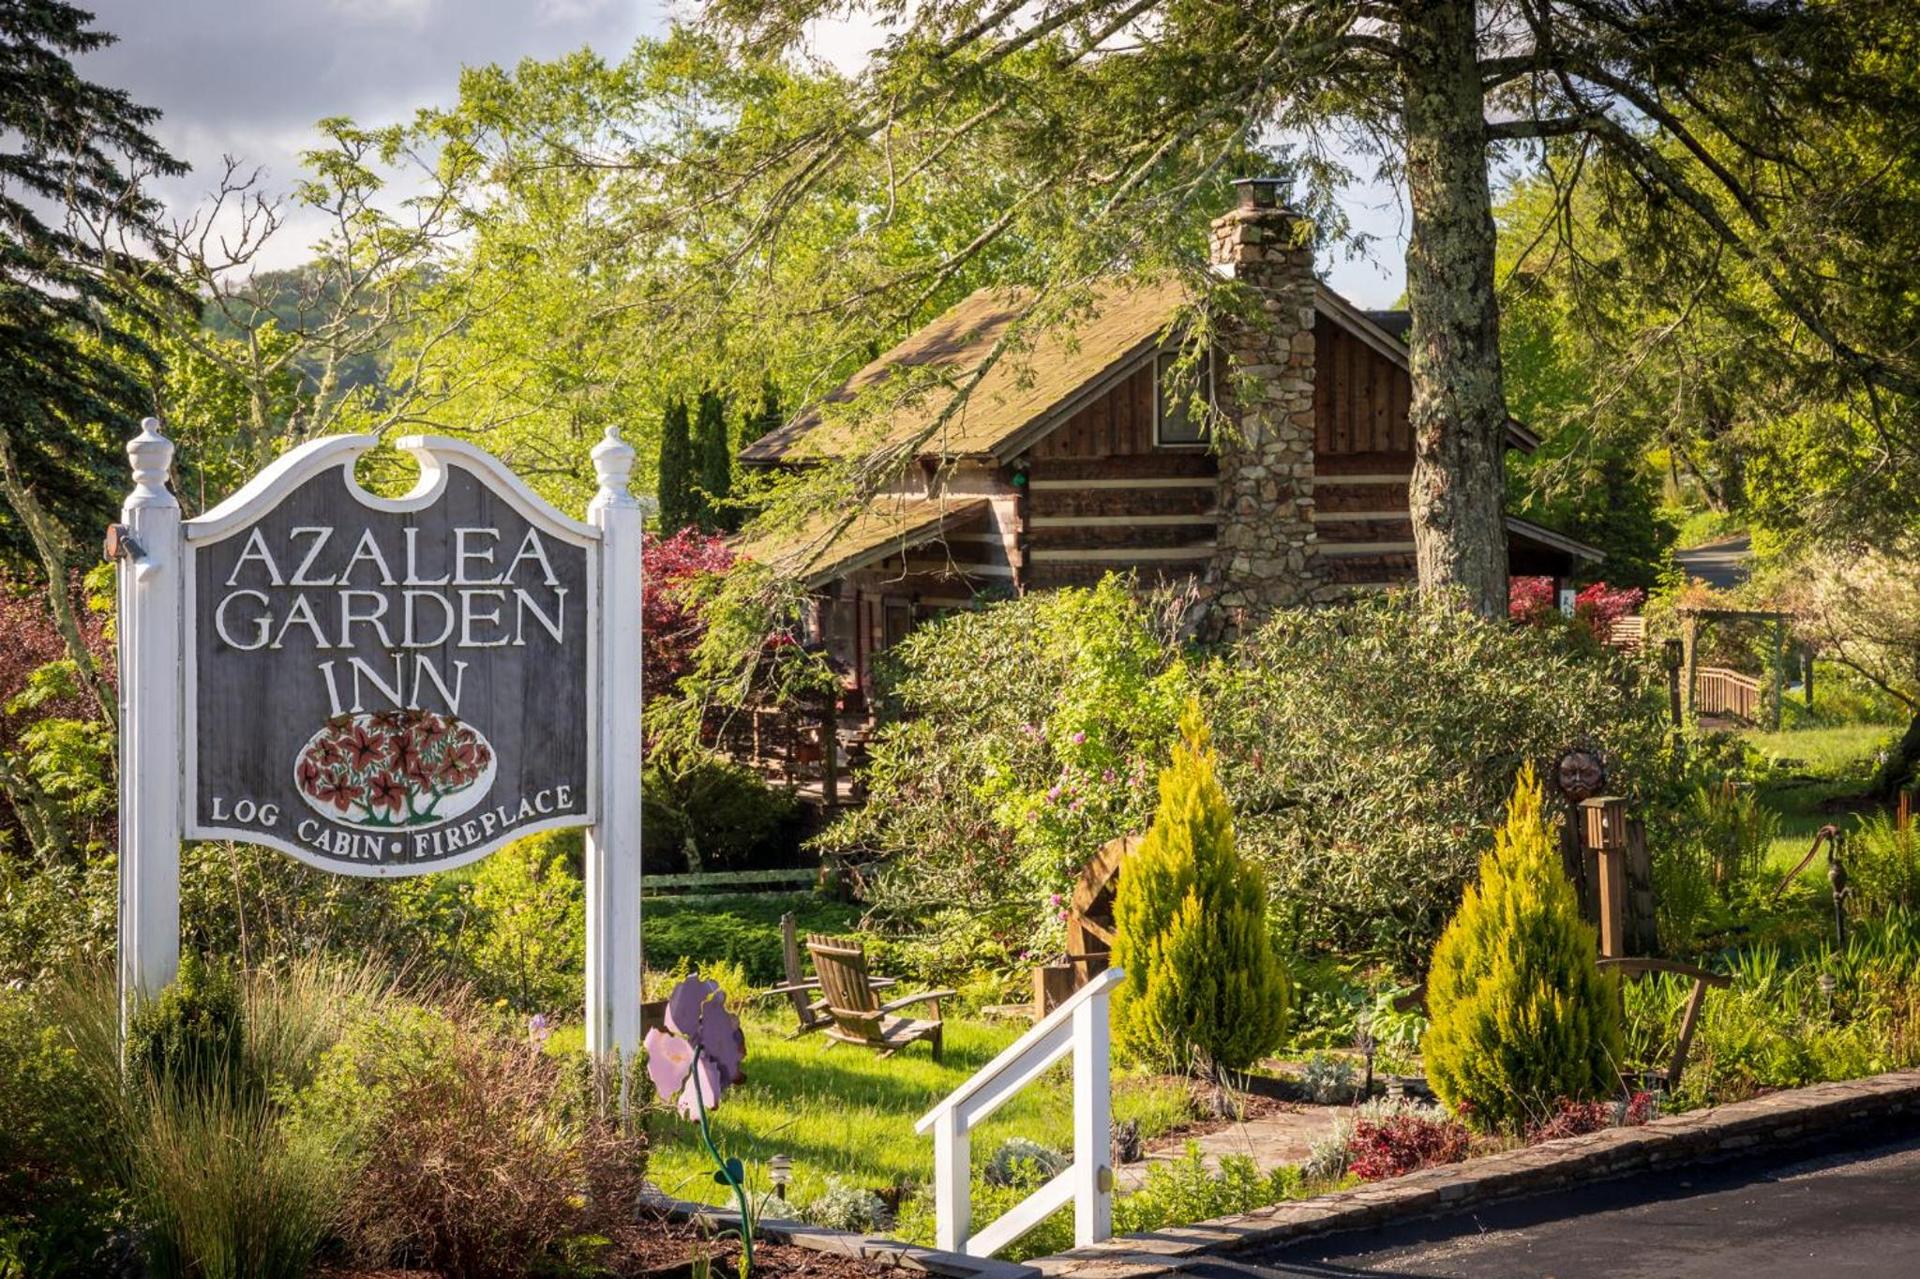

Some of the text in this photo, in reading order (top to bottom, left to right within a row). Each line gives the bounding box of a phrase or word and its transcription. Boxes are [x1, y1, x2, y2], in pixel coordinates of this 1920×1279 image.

[226, 526, 560, 586] AZALEA
[215, 589, 569, 650] GARDEN
[318, 653, 468, 717] INN
[211, 785, 574, 861] LOG CABIN FIREPLACE
